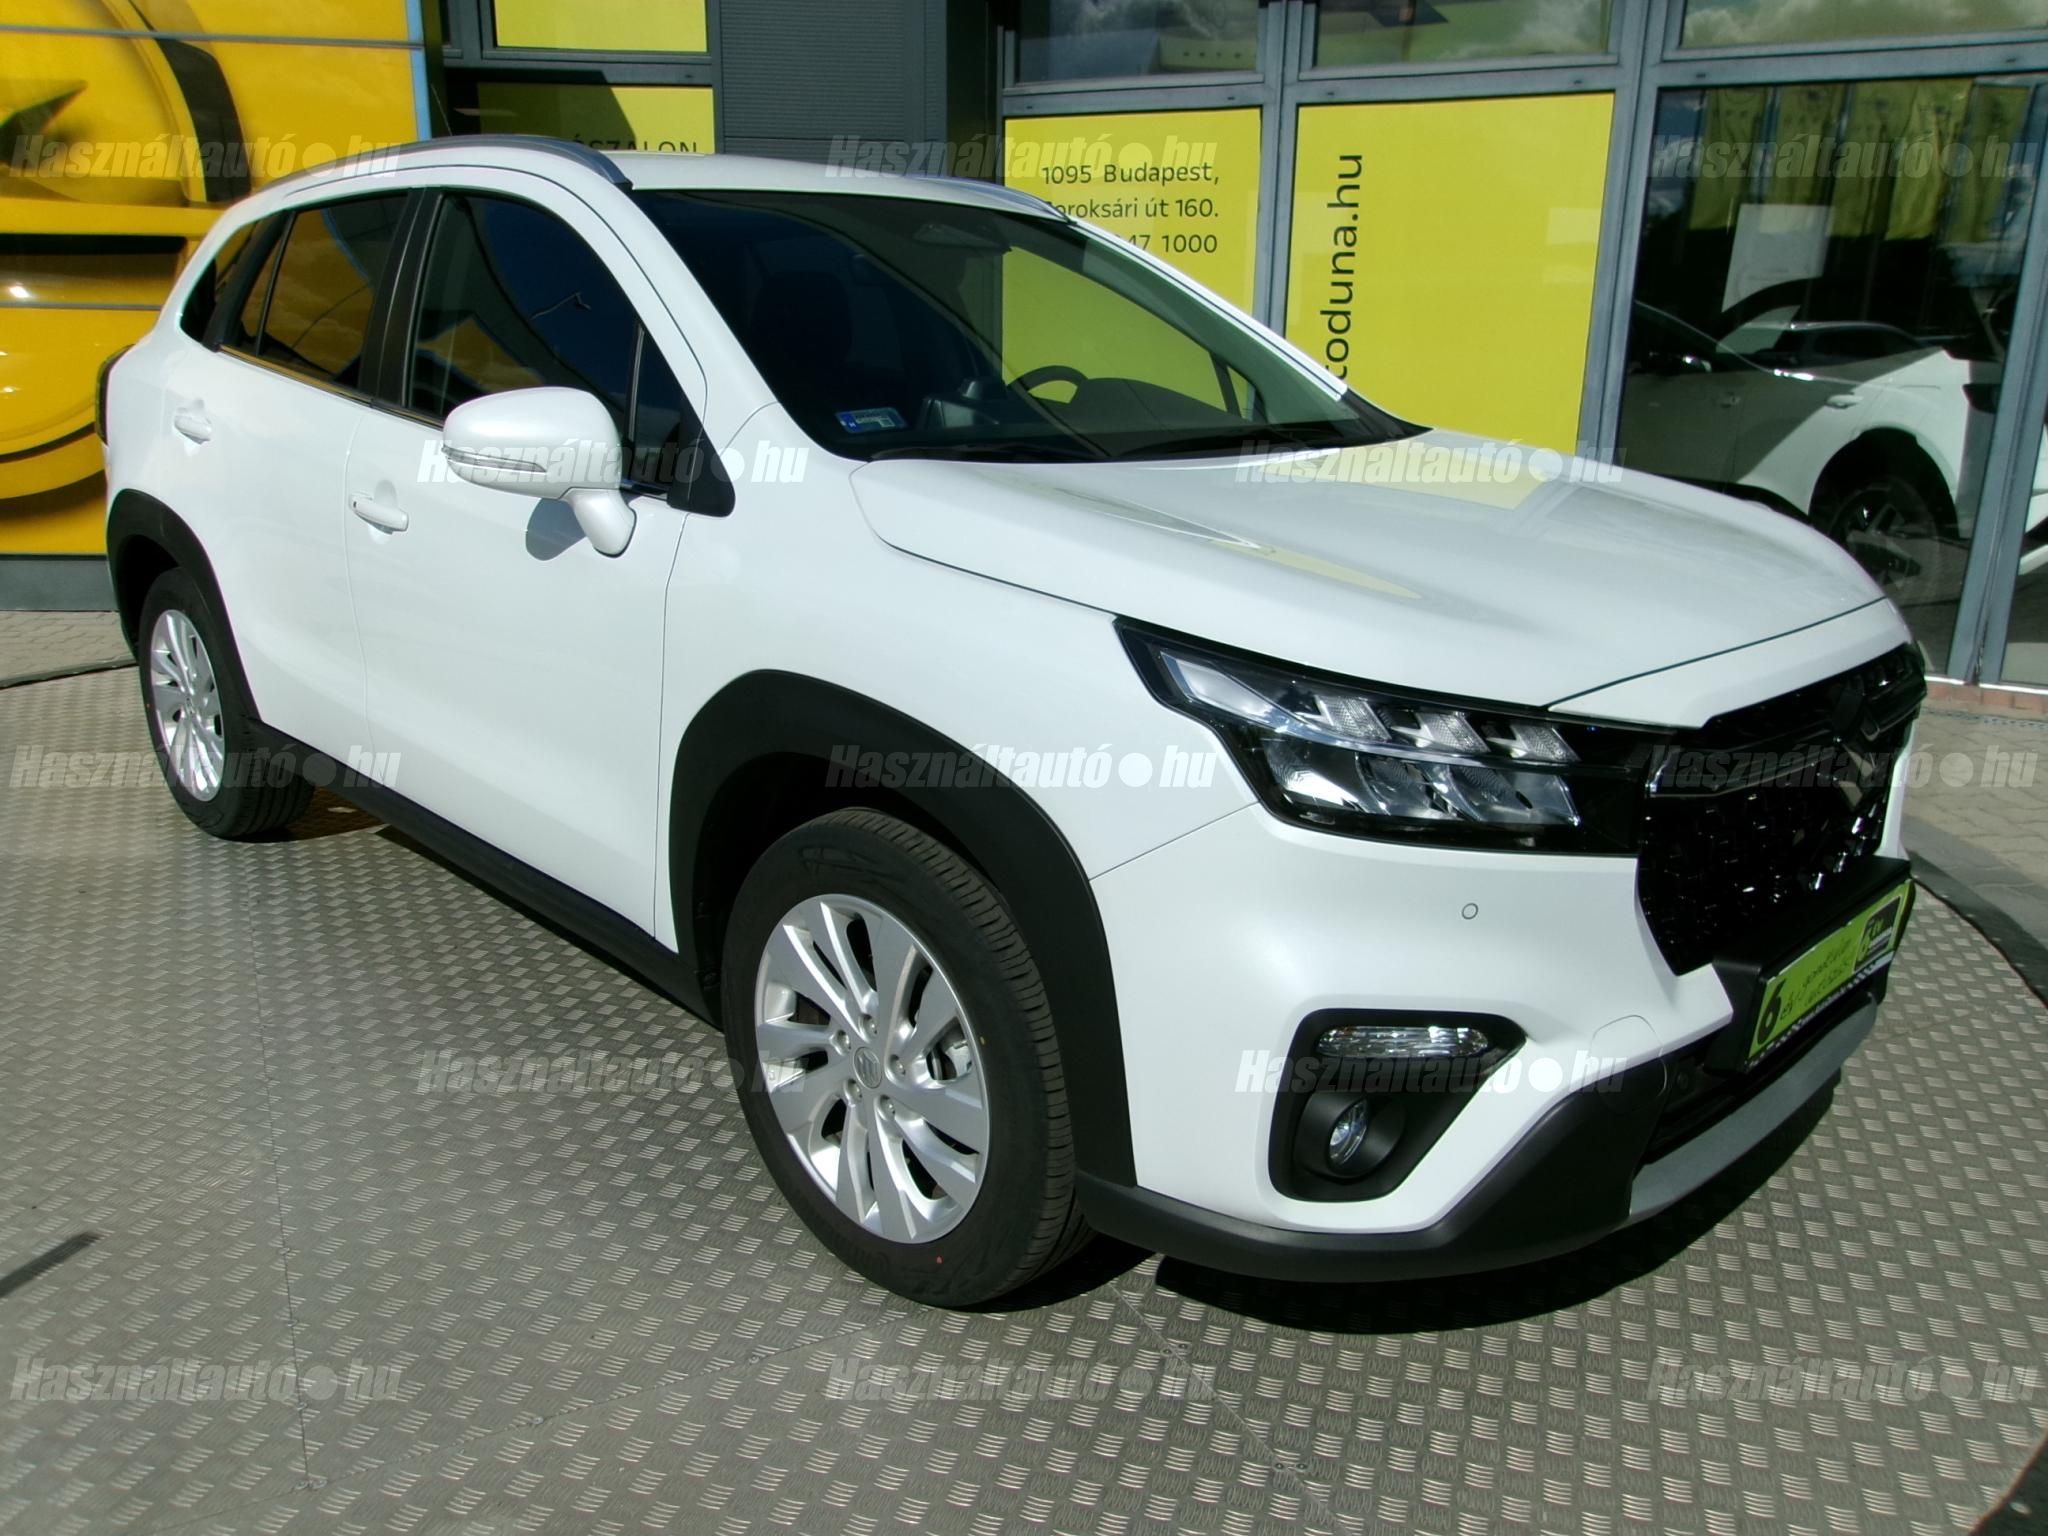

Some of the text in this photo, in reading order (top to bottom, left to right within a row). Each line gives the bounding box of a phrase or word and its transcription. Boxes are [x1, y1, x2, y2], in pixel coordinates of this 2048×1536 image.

[1042, 162, 1220, 187] 1095 Budapest,
[1047, 197, 1220, 218] oroksári út 160.
[1161, 234, 1218, 254] 1000
